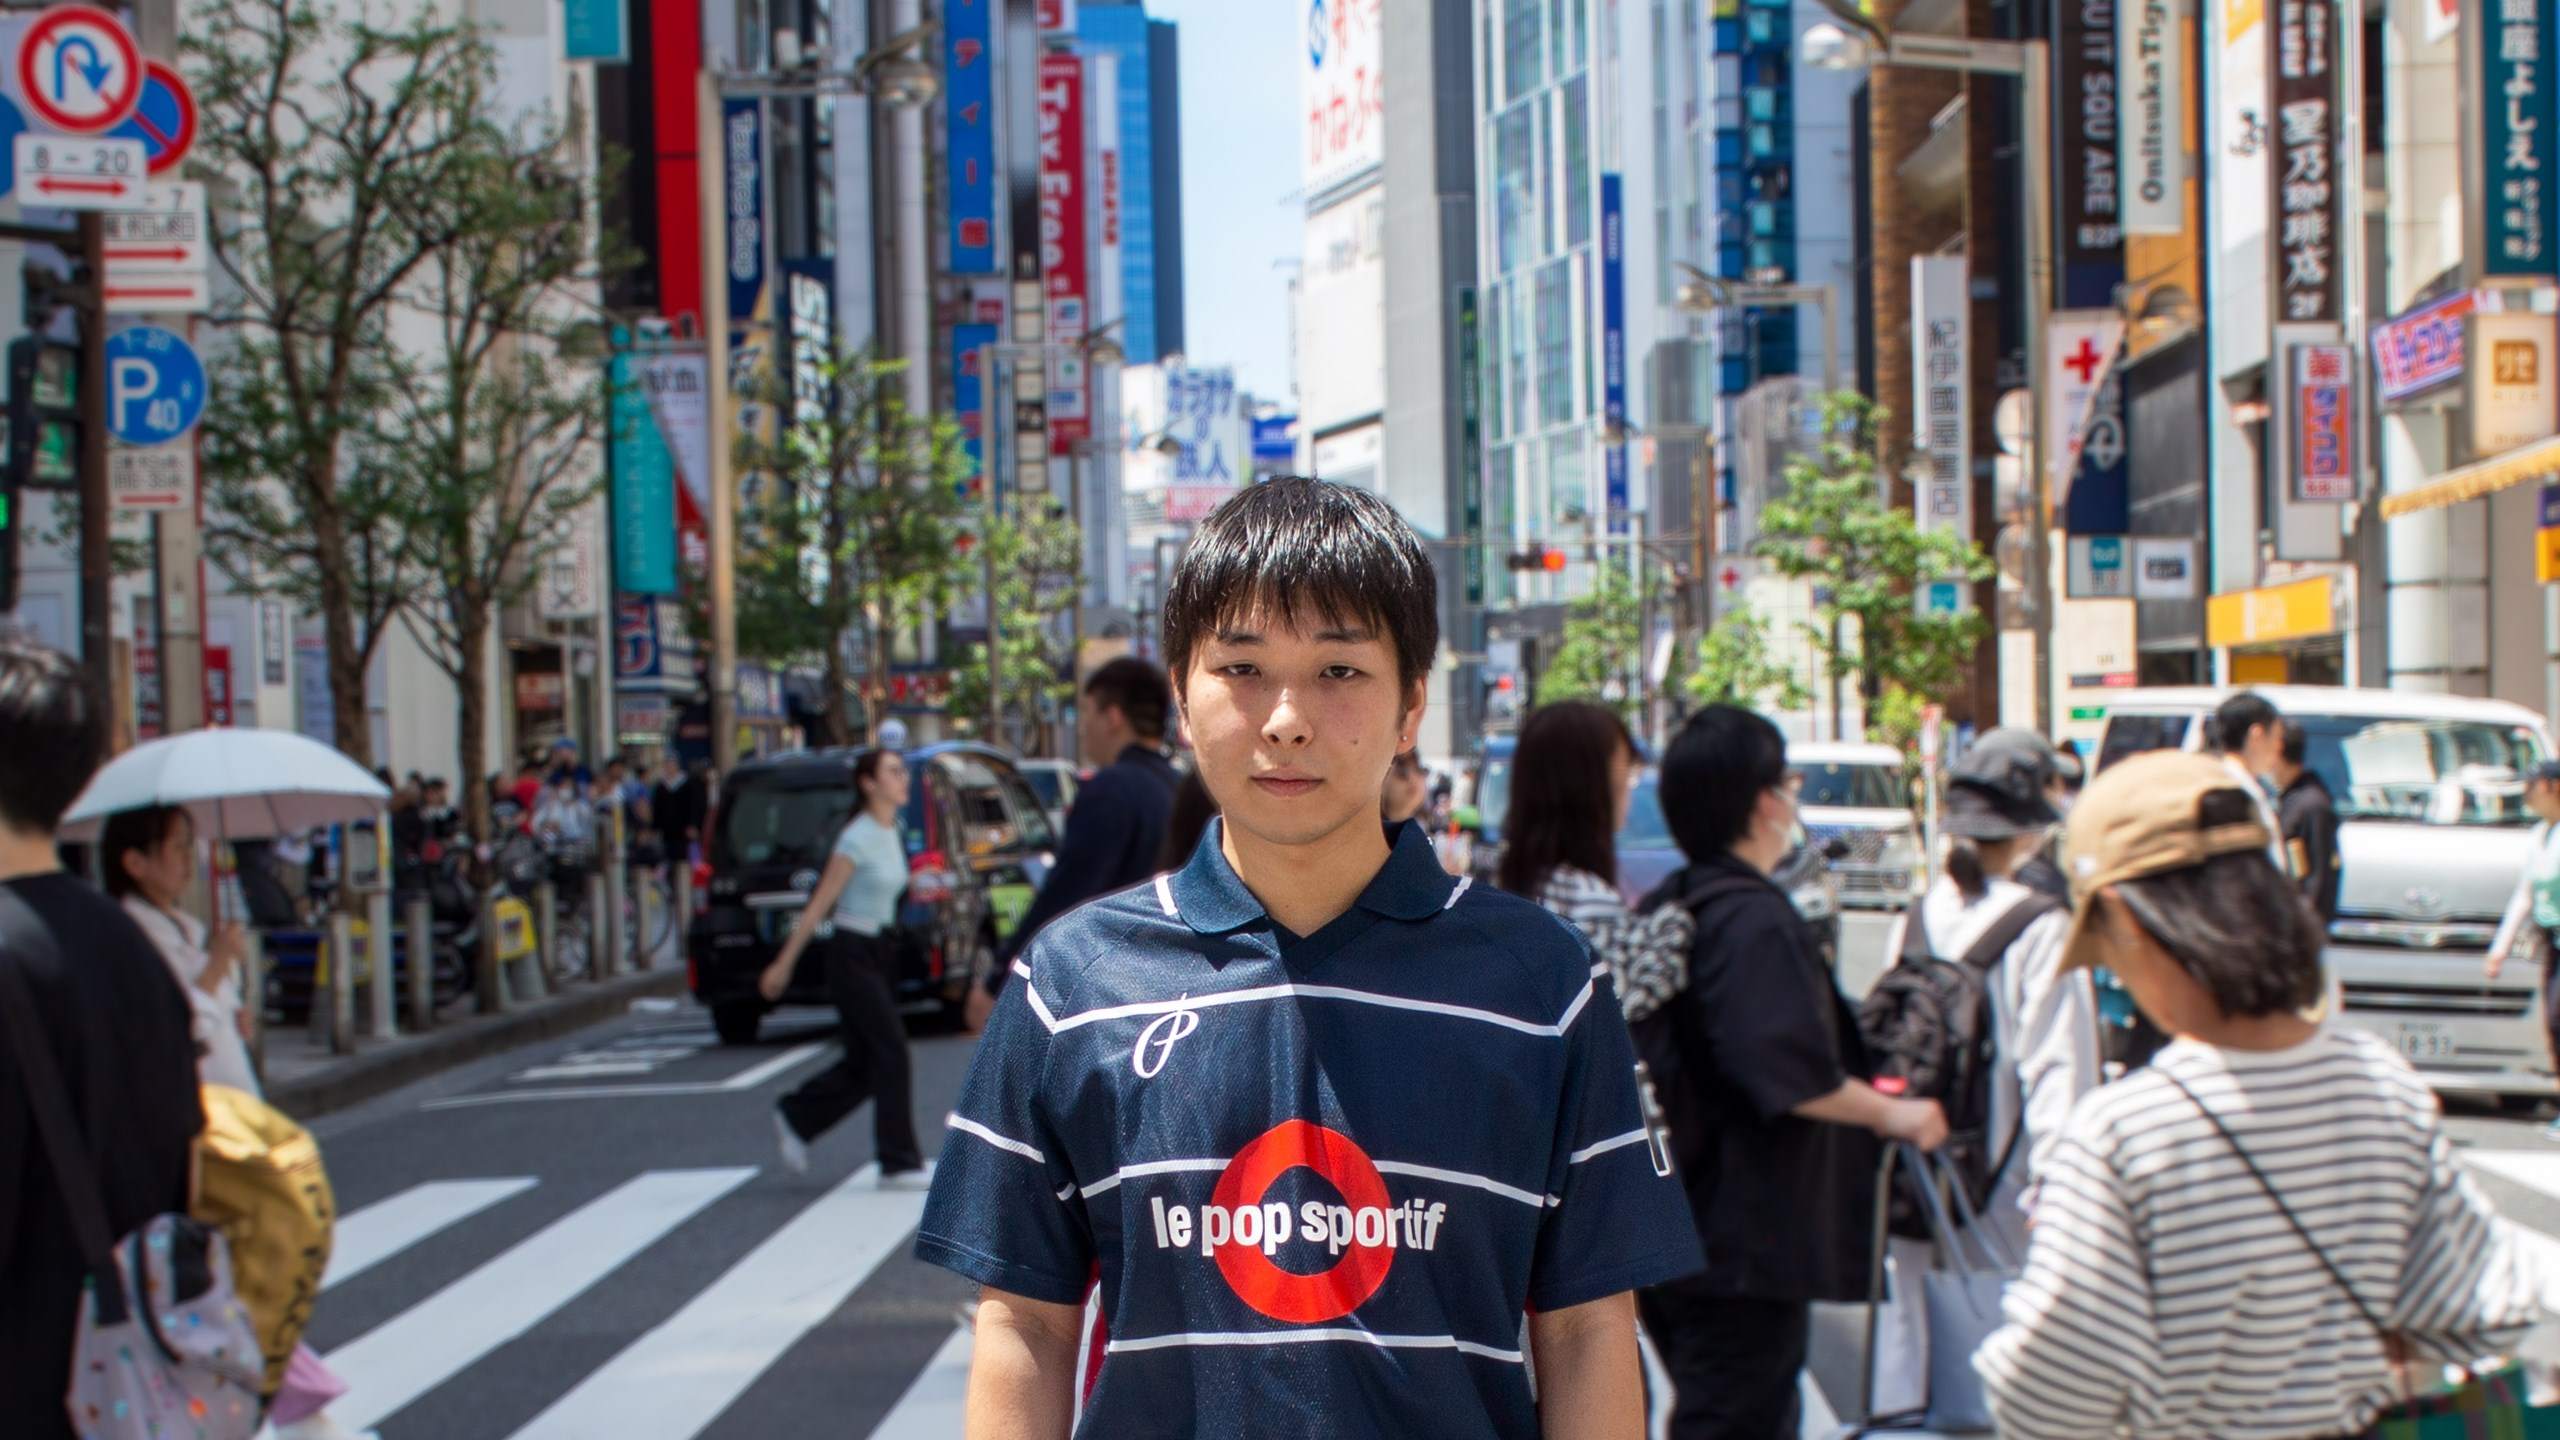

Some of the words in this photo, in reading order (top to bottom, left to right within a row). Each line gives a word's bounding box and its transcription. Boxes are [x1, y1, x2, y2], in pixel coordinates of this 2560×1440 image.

[95, 149, 129, 173] 20
[111, 357, 157, 432] P
[146, 398, 180, 431] 40
[1928, 319, 1960, 517] 紀伊國屋書店
[1151, 1196, 1192, 1249] le
[1201, 1201, 1292, 1257] pop
[1300, 1198, 1447, 1255] sportif
